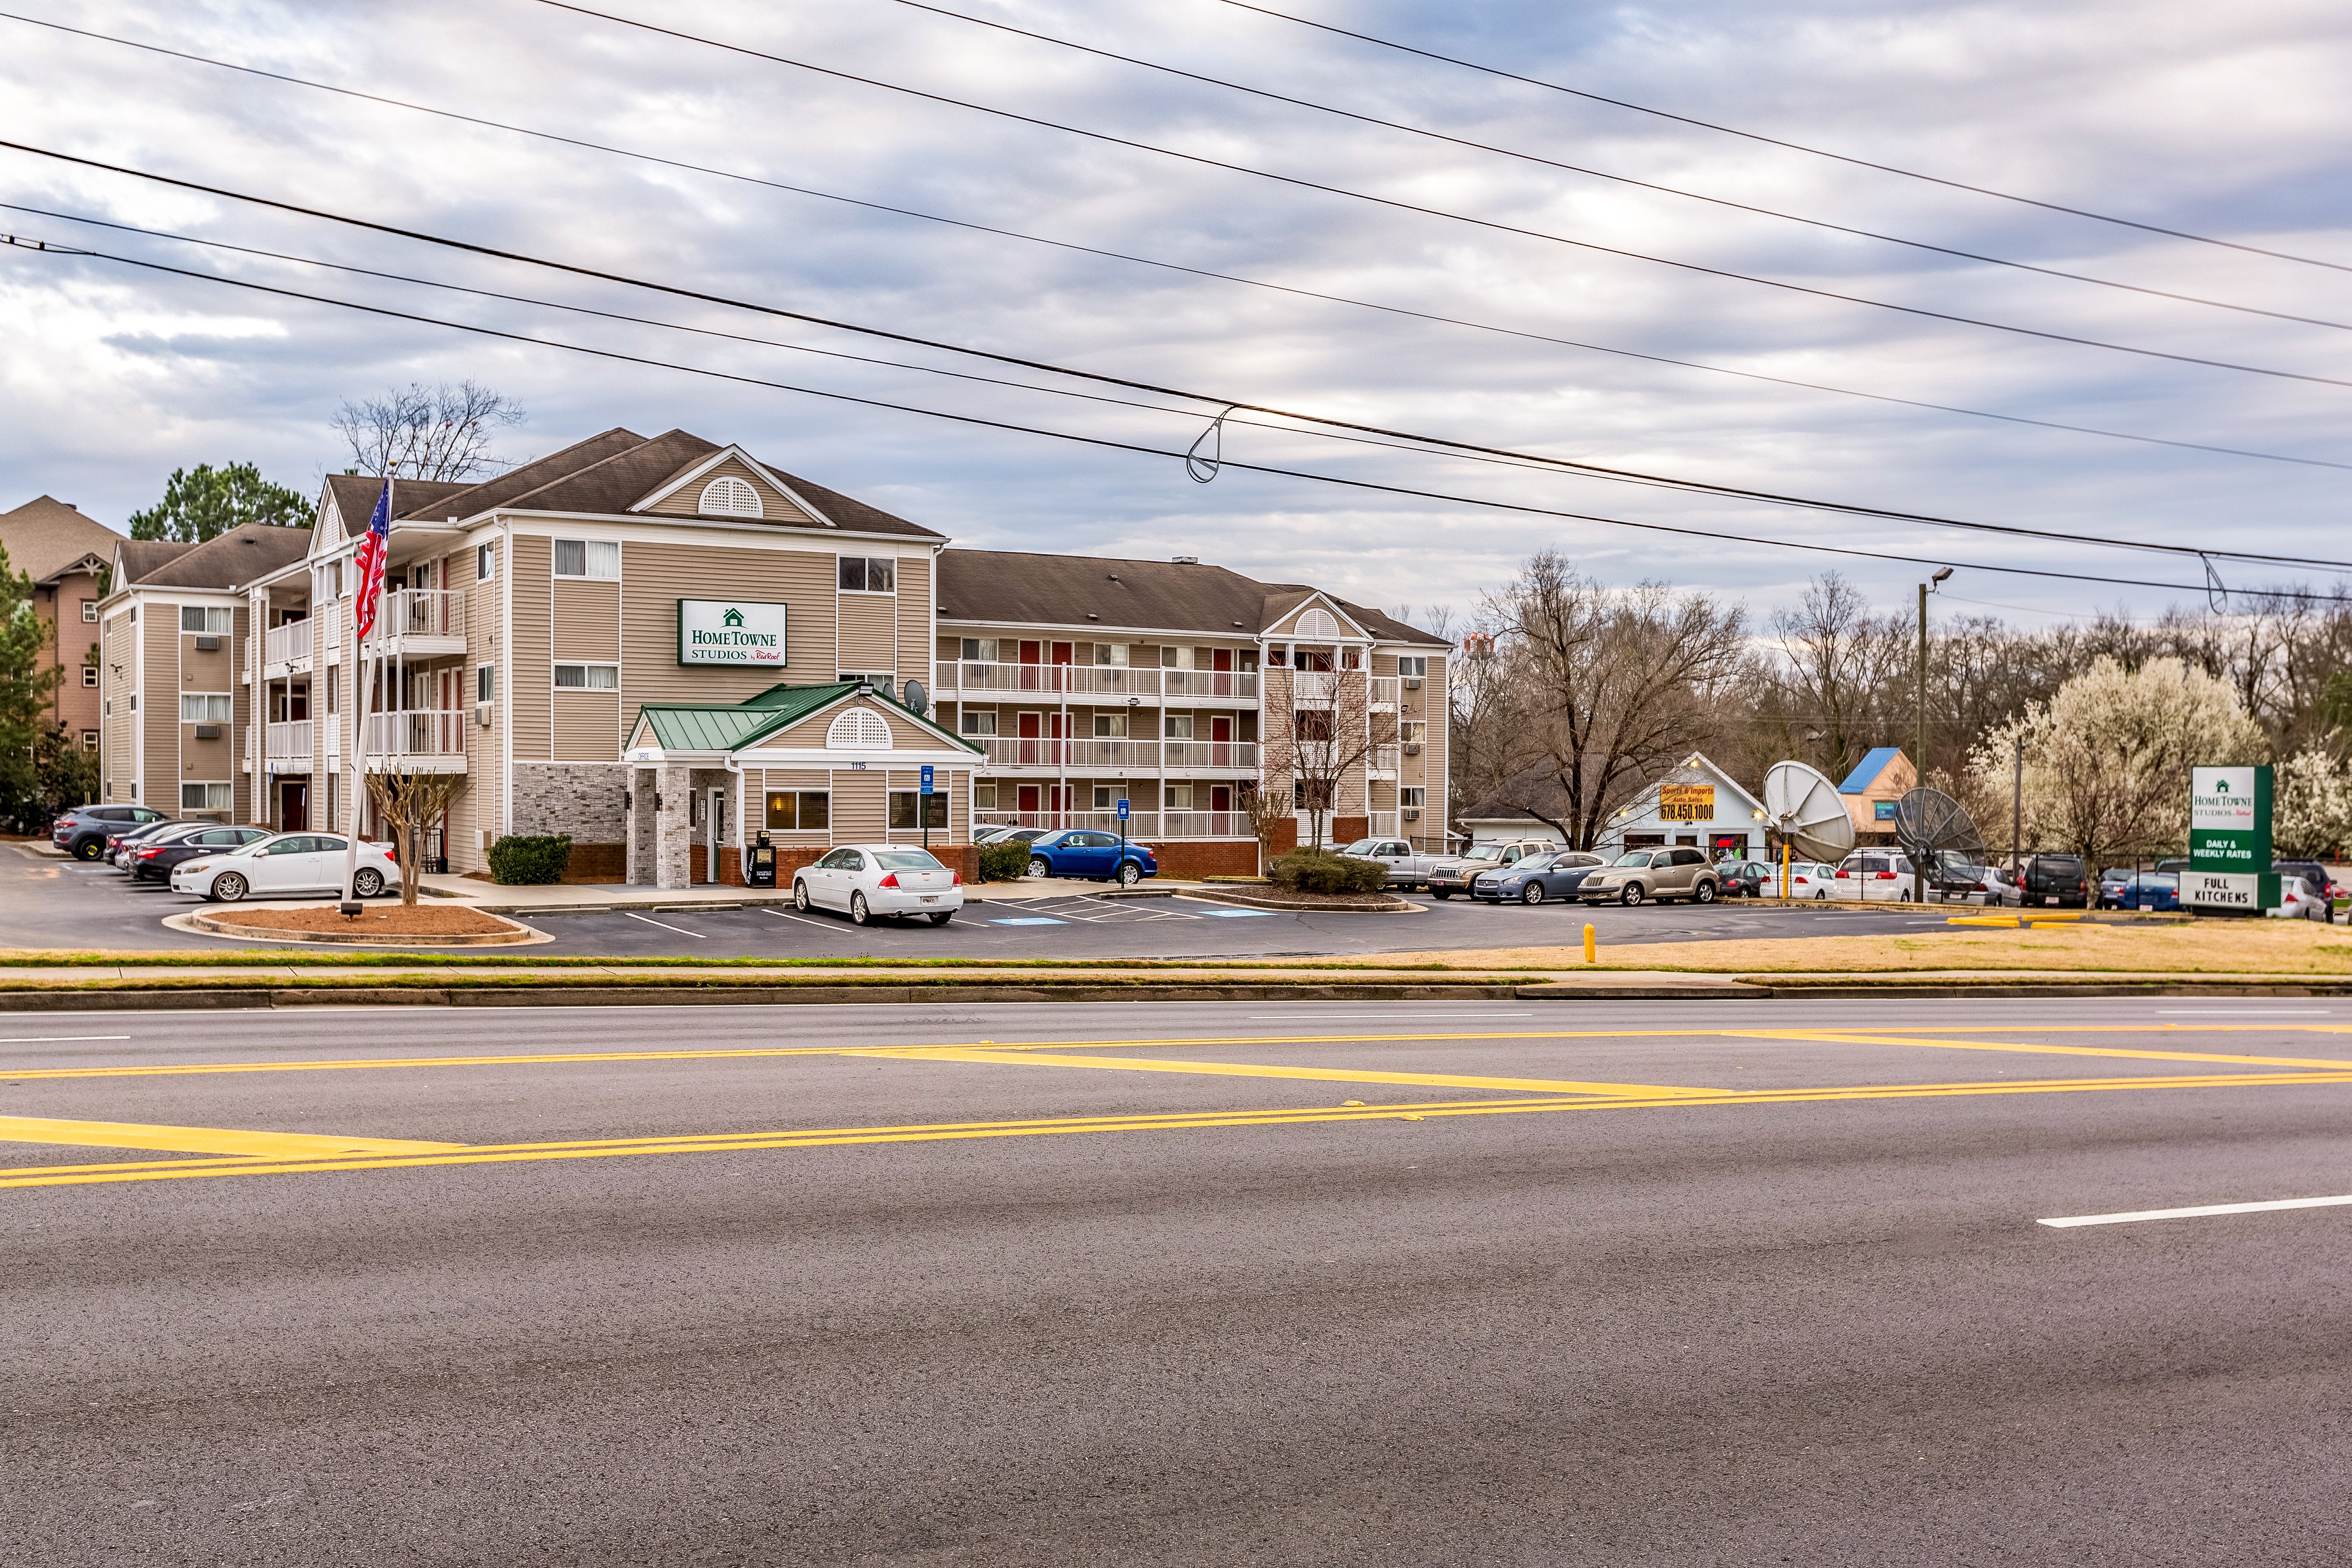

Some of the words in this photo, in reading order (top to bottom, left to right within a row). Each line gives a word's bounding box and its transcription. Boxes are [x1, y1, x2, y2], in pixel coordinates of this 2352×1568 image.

[692, 650, 747, 659] STUDIOS
[851, 762, 866, 770] 1115
[1662, 786, 1682, 796] Sports
[1691, 787, 1713, 796] Imports
[1661, 804, 1713, 819] 678.450.1000
[2206, 839, 2228, 848] DAILY
[2230, 840, 2236, 849] &
[2193, 848, 2225, 858] WEEKLY
[2226, 850, 2252, 859] RATES
[2205, 878, 2229, 889] FULL
[2195, 890, 2248, 903] KITCHENS
